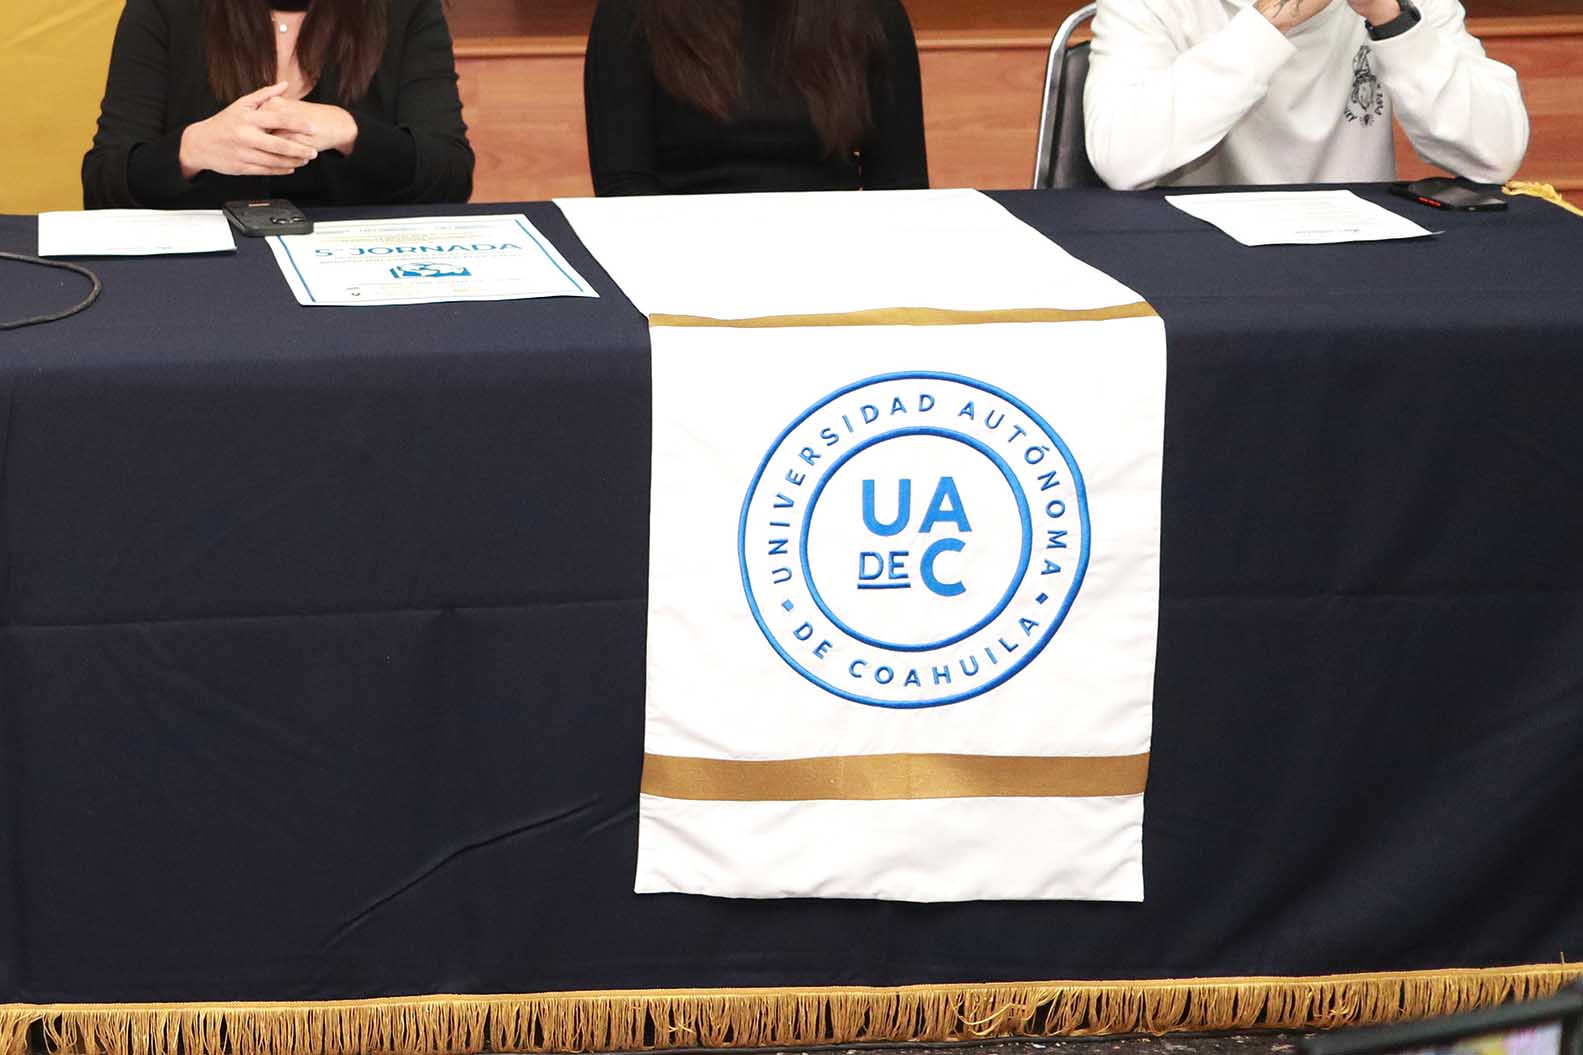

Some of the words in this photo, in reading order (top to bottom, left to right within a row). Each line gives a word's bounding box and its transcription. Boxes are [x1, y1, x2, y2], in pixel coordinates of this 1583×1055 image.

[349, 242, 523, 257] JORNADA
[768, 394, 935, 584] UNIVERSIDAD
[958, 400, 1068, 577] AUTÓNOMA
[862, 476, 972, 537] UA
[858, 550, 911, 582] DE
[920, 537, 967, 597] C
[792, 621, 833, 659] DE
[848, 616, 1040, 688] COAHUILA
